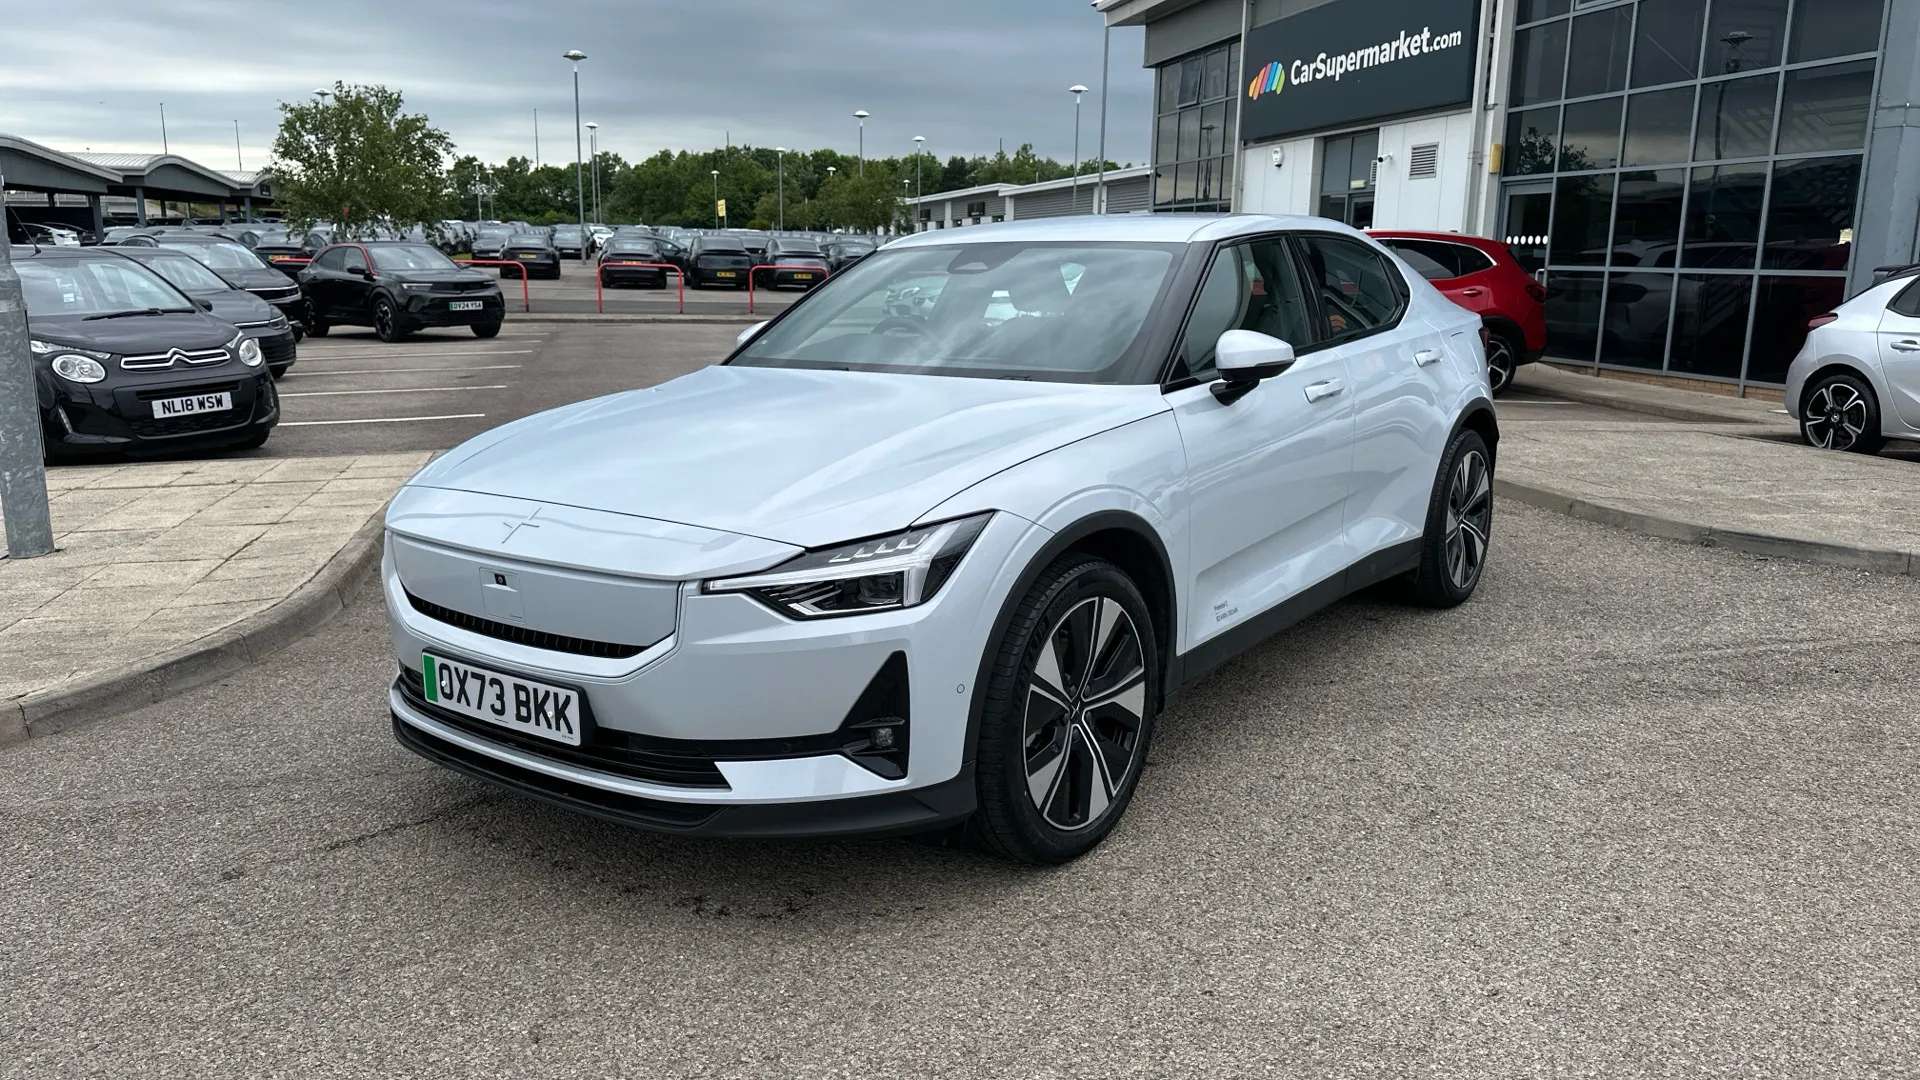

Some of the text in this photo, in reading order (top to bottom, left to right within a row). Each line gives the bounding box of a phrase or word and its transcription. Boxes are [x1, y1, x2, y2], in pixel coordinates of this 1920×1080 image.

[1291, 26, 1461, 85] CarSupermarket.com
[161, 394, 224, 415] NL18 WSW
[438, 662, 574, 735] OX73 BKK
